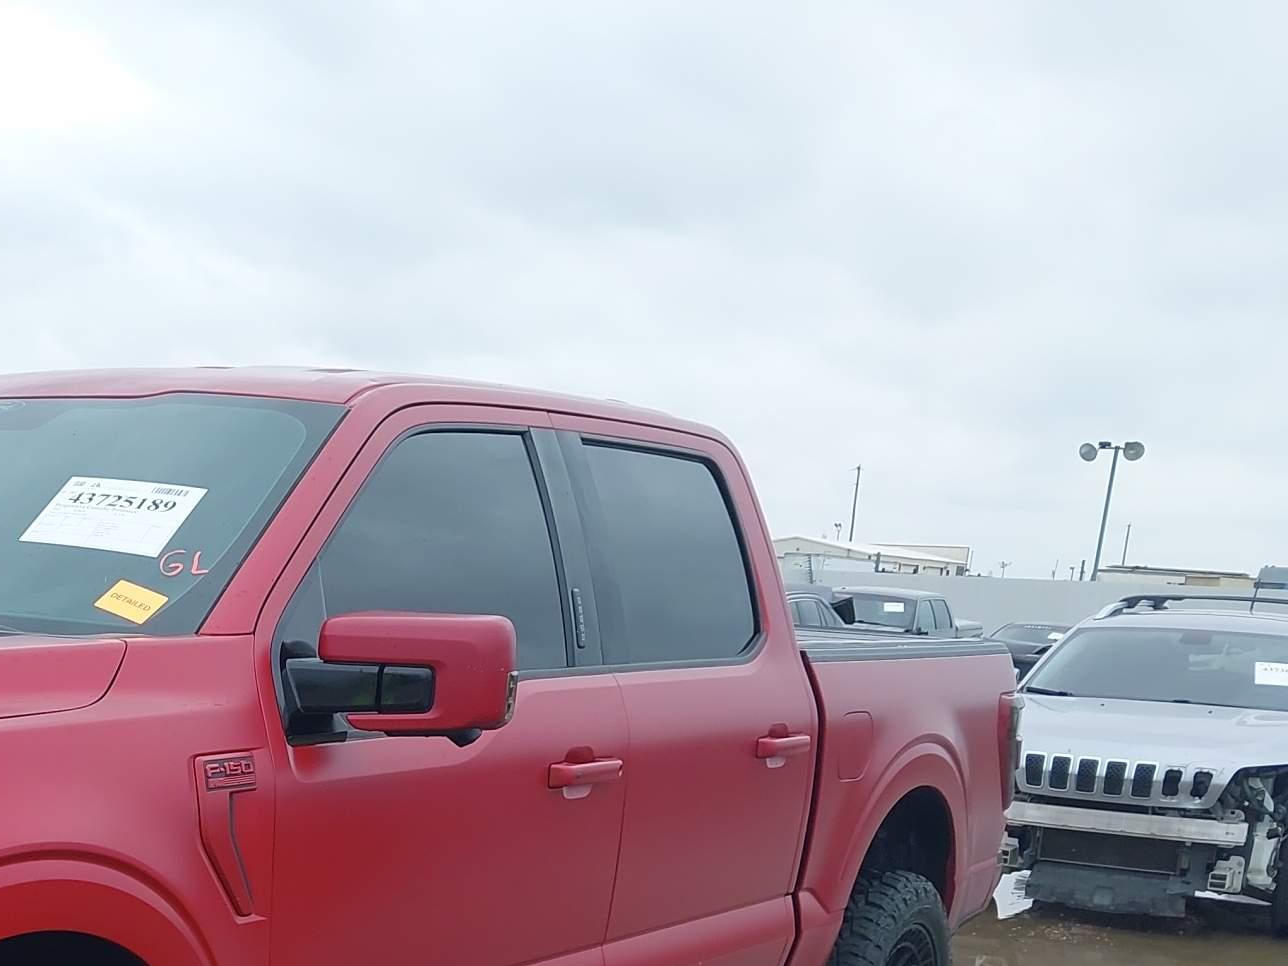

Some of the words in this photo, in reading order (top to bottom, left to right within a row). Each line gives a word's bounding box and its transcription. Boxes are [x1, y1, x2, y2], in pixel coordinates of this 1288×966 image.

[67, 491, 177, 513] 43725189
[159, 549, 210, 577] GL
[109, 591, 152, 613] DETAILED
[205, 760, 254, 778] F-150
